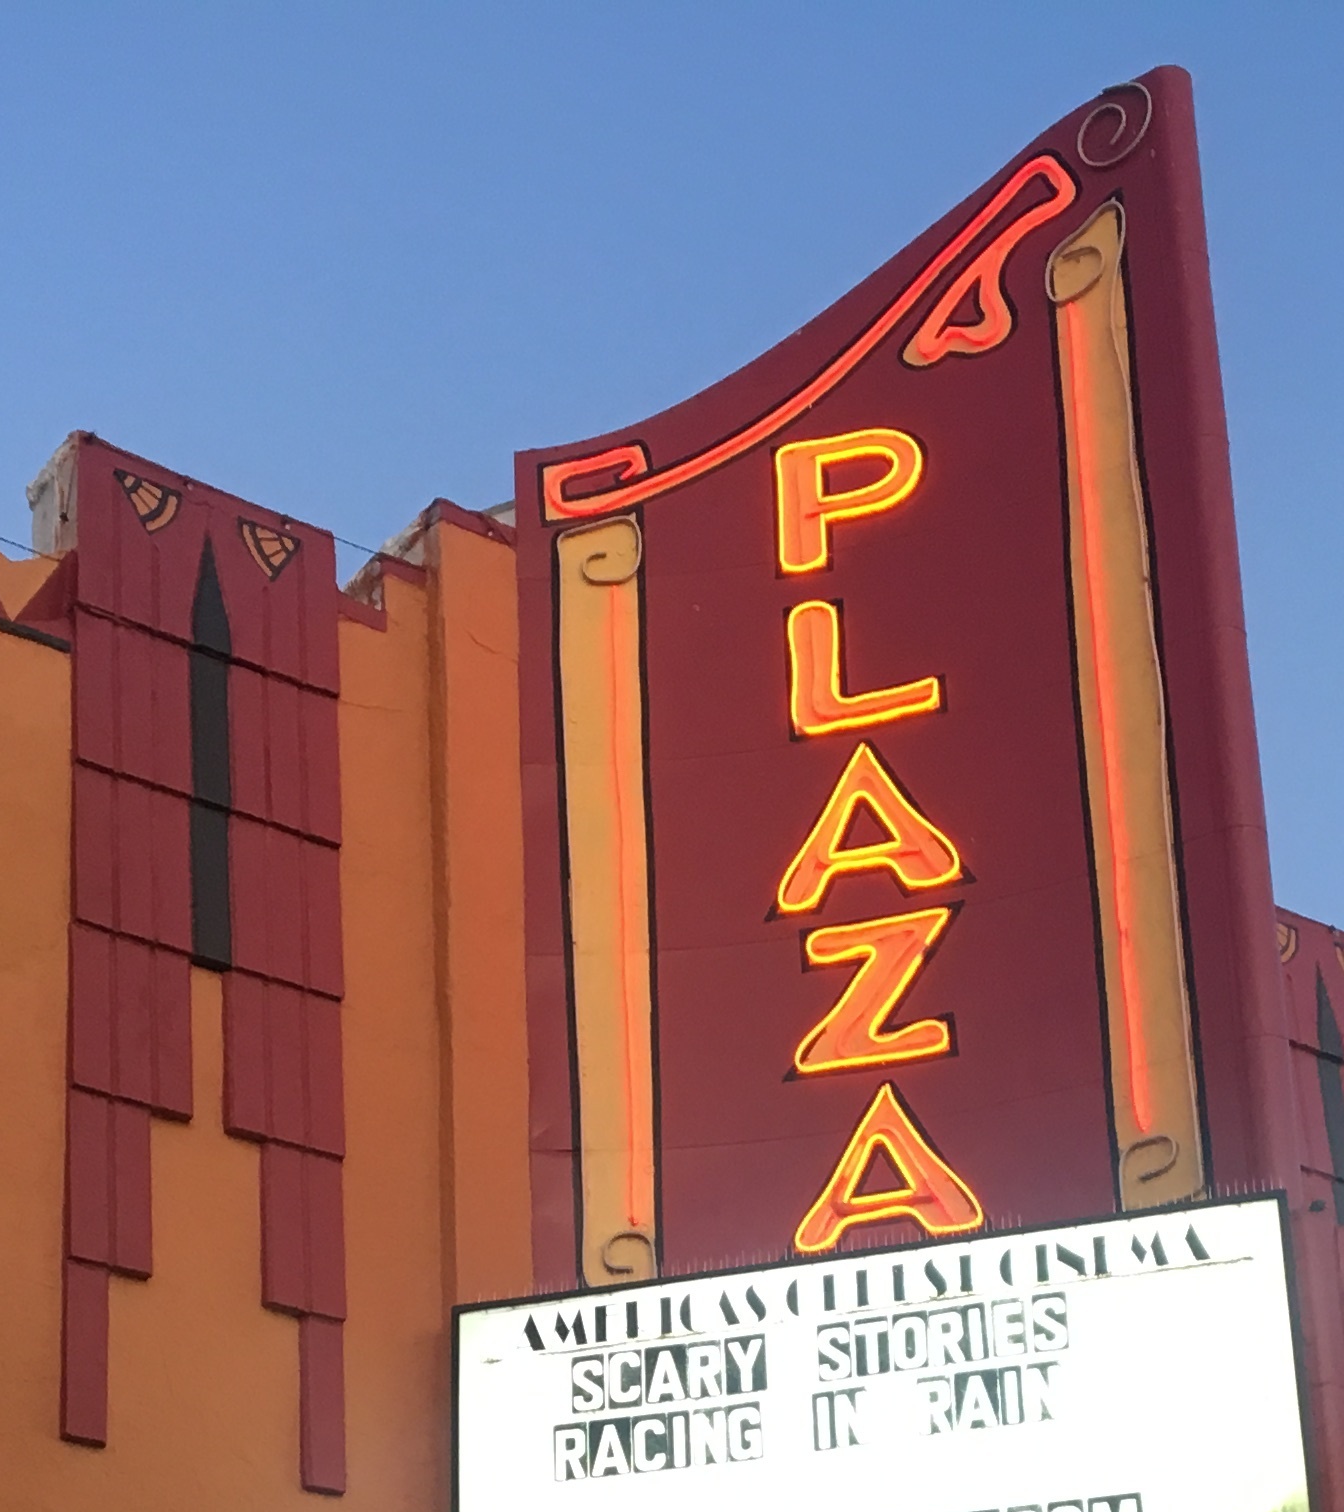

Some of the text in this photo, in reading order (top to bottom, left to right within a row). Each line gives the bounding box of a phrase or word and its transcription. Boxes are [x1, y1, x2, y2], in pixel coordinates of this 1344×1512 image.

[775, 426, 984, 1254] PLAZA
[572, 1292, 1069, 1414] SCARY STORIES
[553, 1360, 1060, 1482] RACING IN RAIN
